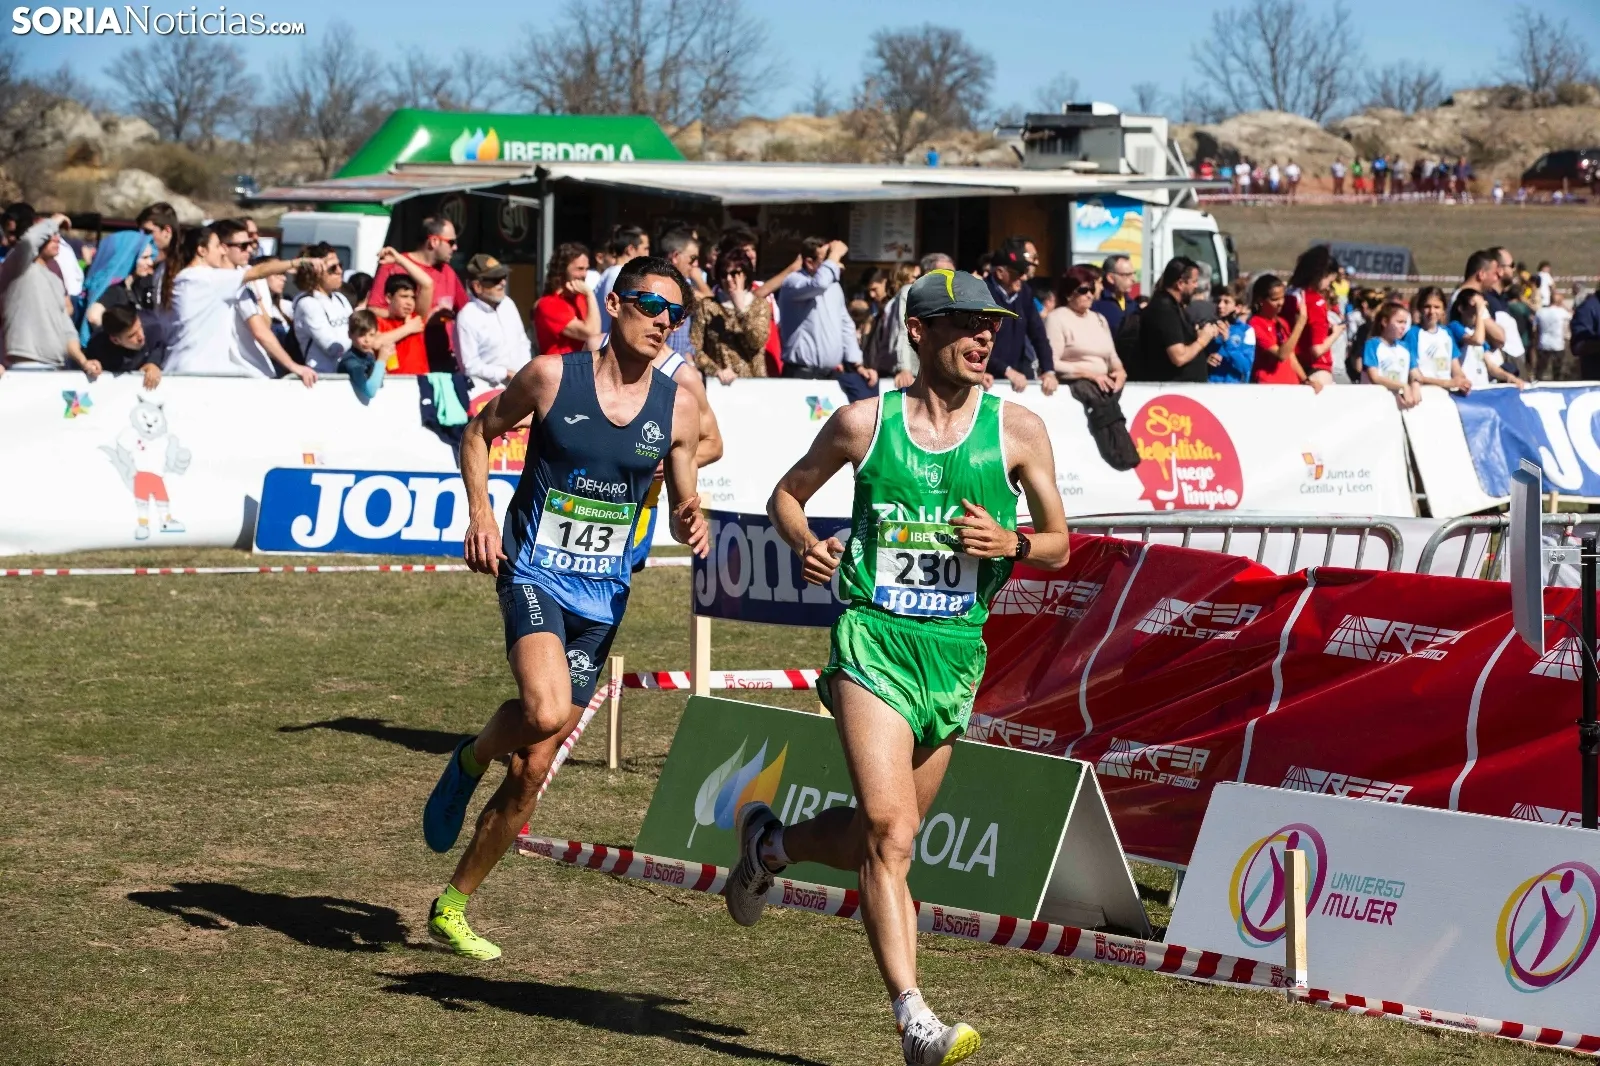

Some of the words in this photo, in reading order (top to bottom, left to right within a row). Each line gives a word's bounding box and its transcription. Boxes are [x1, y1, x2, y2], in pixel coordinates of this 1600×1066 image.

[1145, 405, 1192, 437] Soy
[1327, 470, 1355, 479] Junta
[1357, 469, 1371, 478] de
[1300, 484, 1334, 494] Castilla
[574, 504, 629, 521] IBERDROLA
[558, 520, 614, 553] 143
[895, 552, 961, 588] 230
[1133, 768, 1201, 790] ATLETISMO
[653, 862, 686, 884] Soria
[793, 887, 828, 911] Soria
[1321, 892, 1398, 926] MUJER
[943, 914, 981, 938] Soria
[1107, 941, 1147, 966] Soria
